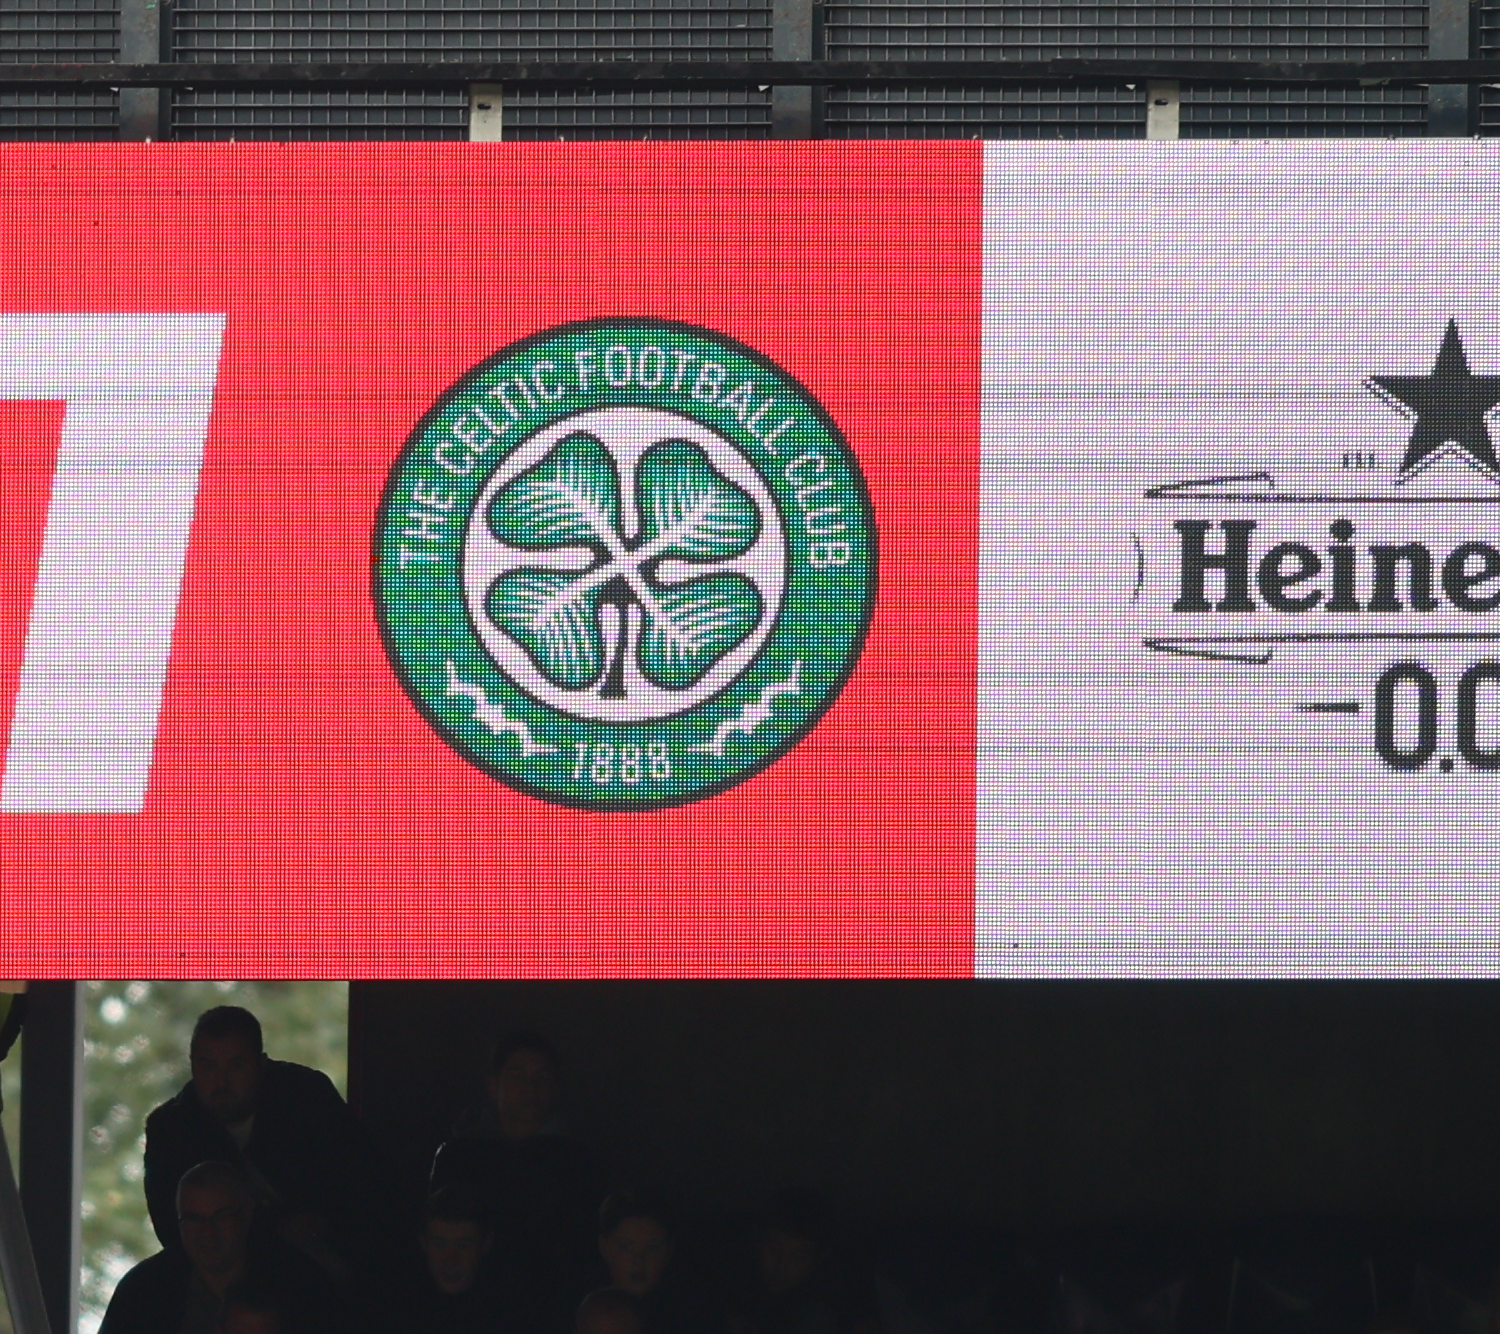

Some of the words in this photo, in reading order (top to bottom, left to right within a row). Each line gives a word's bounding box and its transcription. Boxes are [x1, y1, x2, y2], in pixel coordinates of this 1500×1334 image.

[400, 479, 453, 573] THE
[448, 355, 569, 475] CELTIC
[574, 344, 788, 459] FOOTBALL
[782, 445, 853, 569] CLUB
[568, 741, 674, 784] 1888
